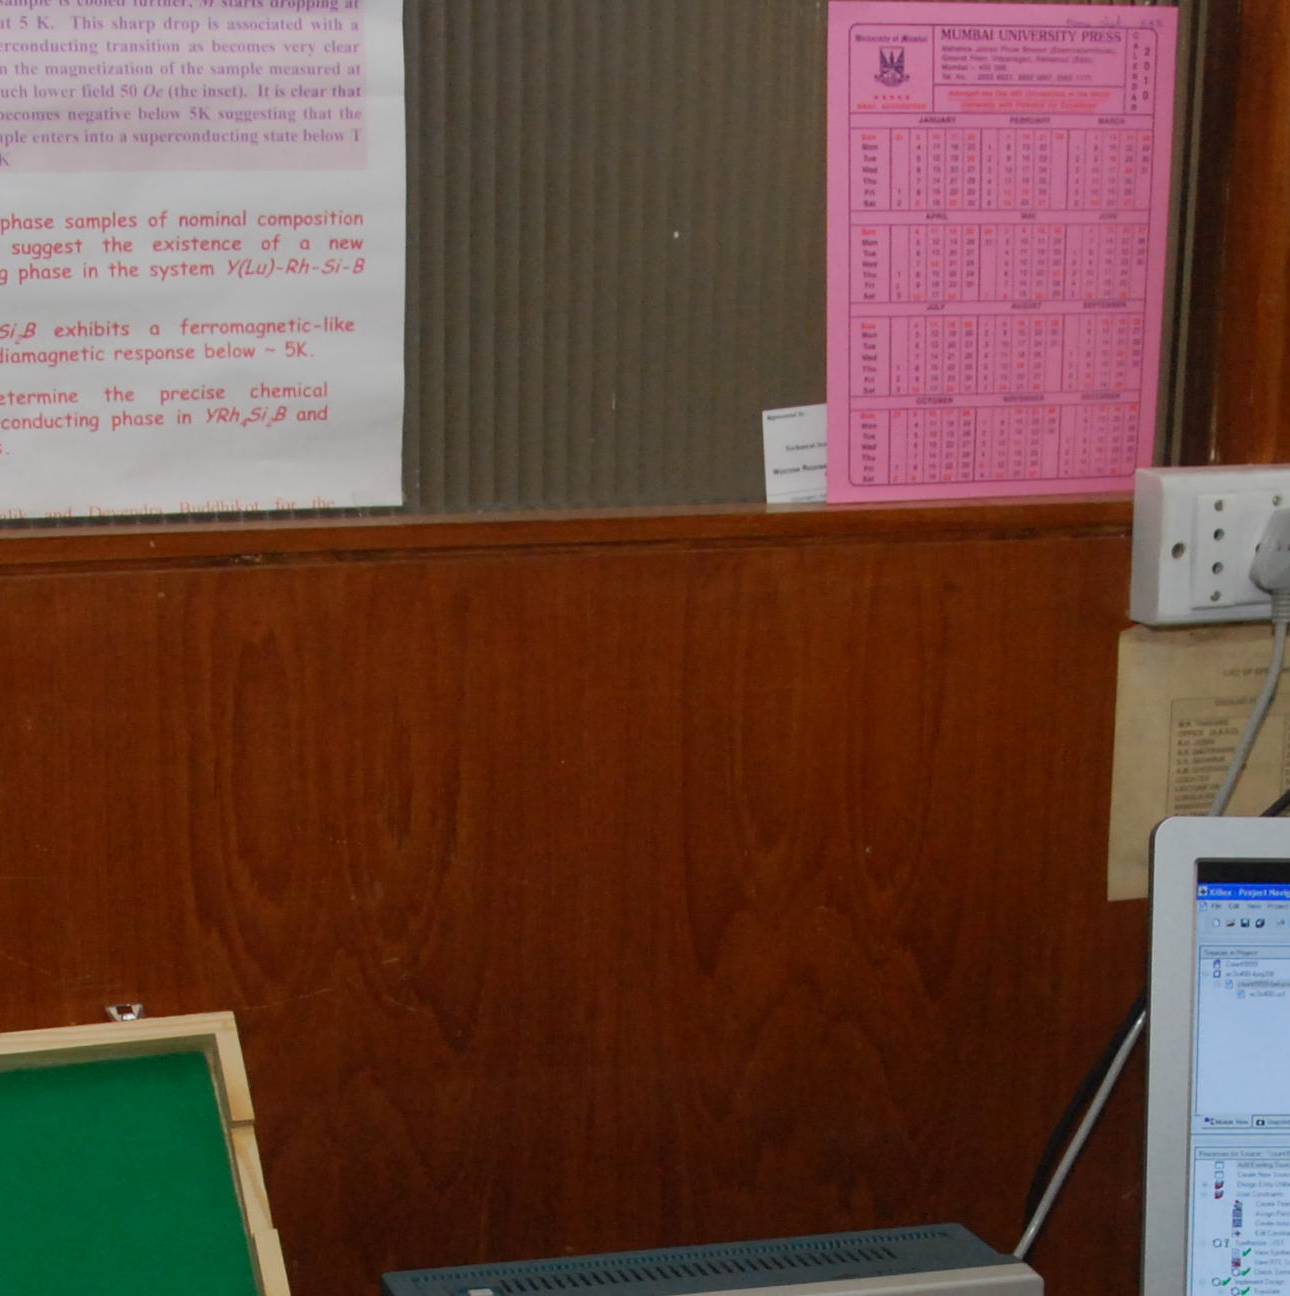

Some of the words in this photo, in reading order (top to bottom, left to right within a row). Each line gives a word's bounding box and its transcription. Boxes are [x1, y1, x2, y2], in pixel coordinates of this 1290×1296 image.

[941, 28, 994, 41] MUMBAI
[999, 29, 1077, 42] UNIVERSITY
[1081, 31, 1122, 43] PRESS
[106, 39, 180, 54] transition
[188, 42, 204, 53] as
[211, 39, 275, 53] becomes
[283, 42, 315, 55] very
[324, 39, 360, 53] clear
[14, 62, 39, 76] the
[44, 61, 153, 78] magnetization
[159, 61, 175, 75] of
[180, 62, 204, 75] the
[210, 61, 263, 78] sample
[269, 61, 341, 75] measured
[347, 63, 361, 75] at
[65, 212, 138, 234] samples
[148, 211, 169, 228] of
[178, 210, 247, 228] nominal
[257, 210, 364, 231] composition
[11, 238, 83, 260] suggest
[102, 236, 134, 253] the
[152, 237, 242, 252] existence
[261, 236, 281, 251] of
[299, 238, 310, 251] a
[328, 237, 364, 251] new
[18, 263, 72, 281] phase
[83, 263, 98, 279] in
[108, 260, 139, 277] the
[149, 262, 215, 282] system
[54, 321, 130, 338] exhibits
[149, 324, 161, 336] a
[181, 316, 355, 338] ferromagnetic-like
[105, 387, 134, 402] the
[160, 386, 225, 405] precise
[250, 382, 328, 399] chemical
